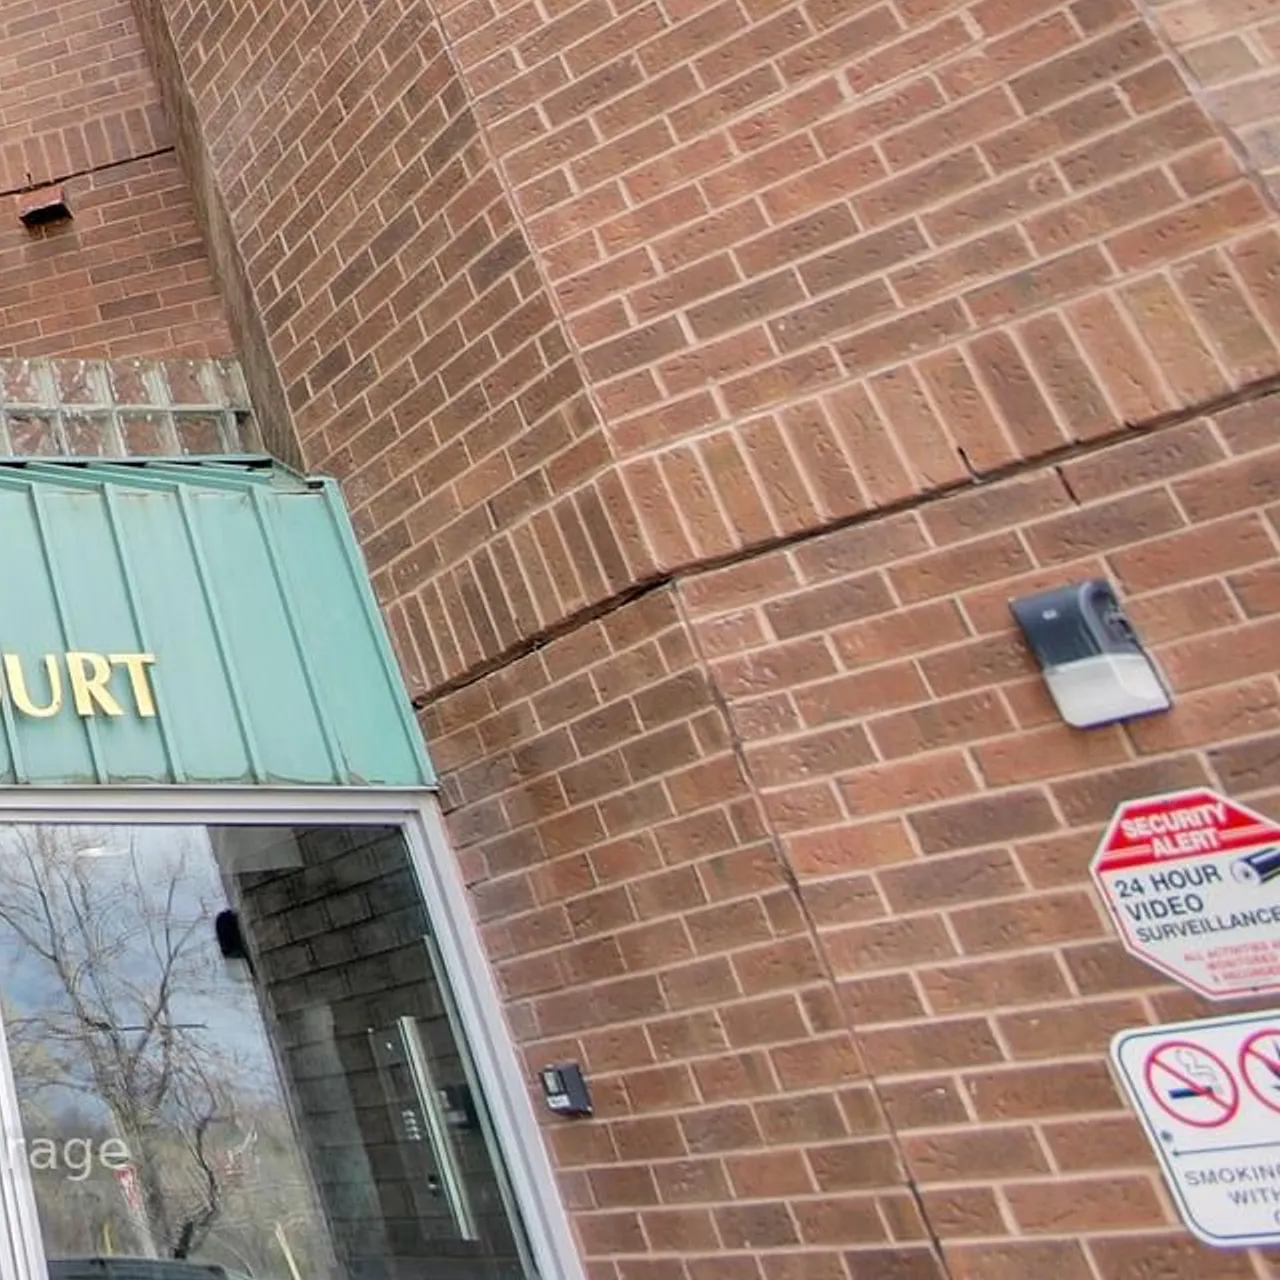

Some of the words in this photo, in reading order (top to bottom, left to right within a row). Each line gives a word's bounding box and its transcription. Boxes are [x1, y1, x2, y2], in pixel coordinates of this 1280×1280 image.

[1120, 802, 1228, 838] SECURITY
[1151, 827, 1221, 858] ALERT
[1114, 877, 1146, 898] 24
[1149, 863, 1223, 892] HOUR
[1125, 893, 1204, 921] VIDEO
[1136, 905, 1280, 943] SURVEILLANCE
